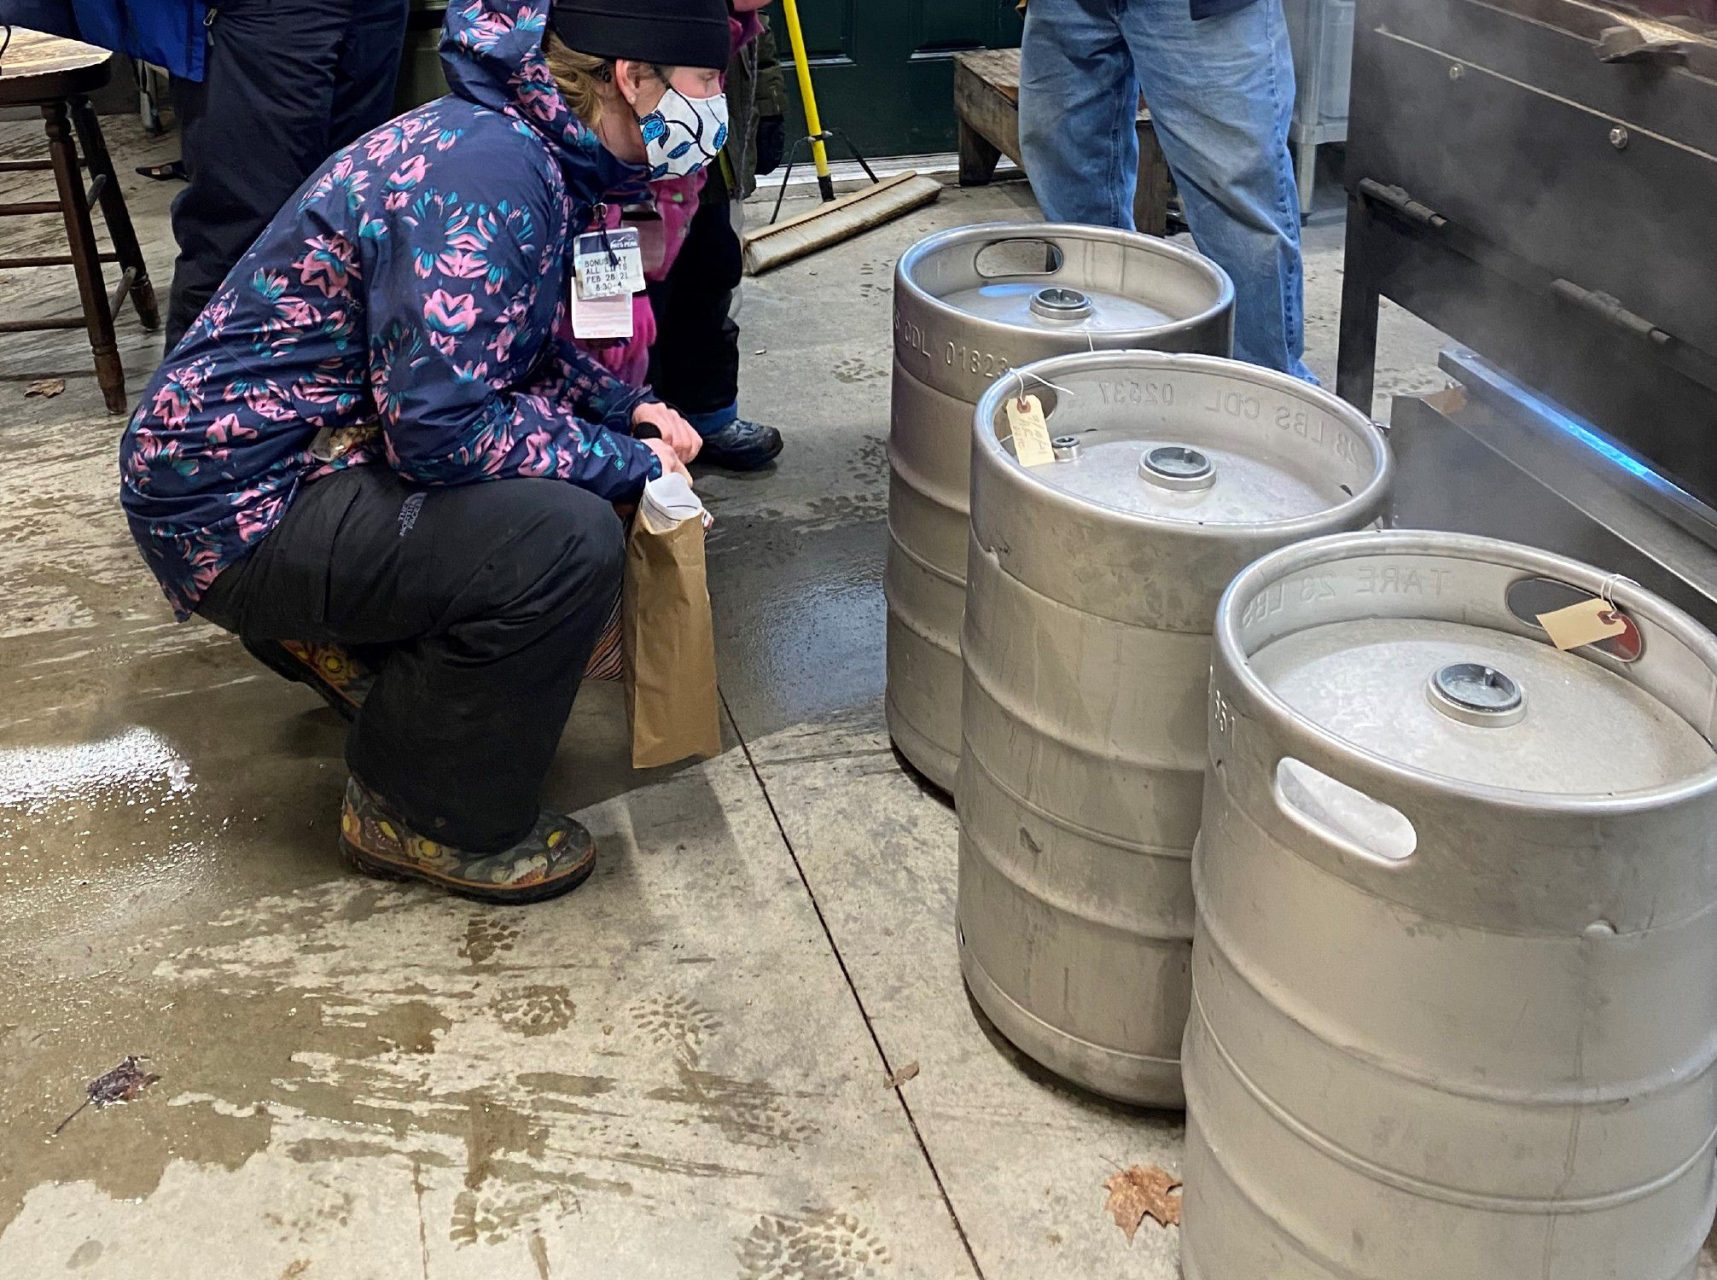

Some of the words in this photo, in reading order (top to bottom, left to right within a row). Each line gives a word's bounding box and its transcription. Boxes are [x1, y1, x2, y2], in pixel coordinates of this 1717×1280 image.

[585, 256, 609, 268] BONUS
[586, 266, 601, 275] ALL
[587, 275, 602, 284] FEB
